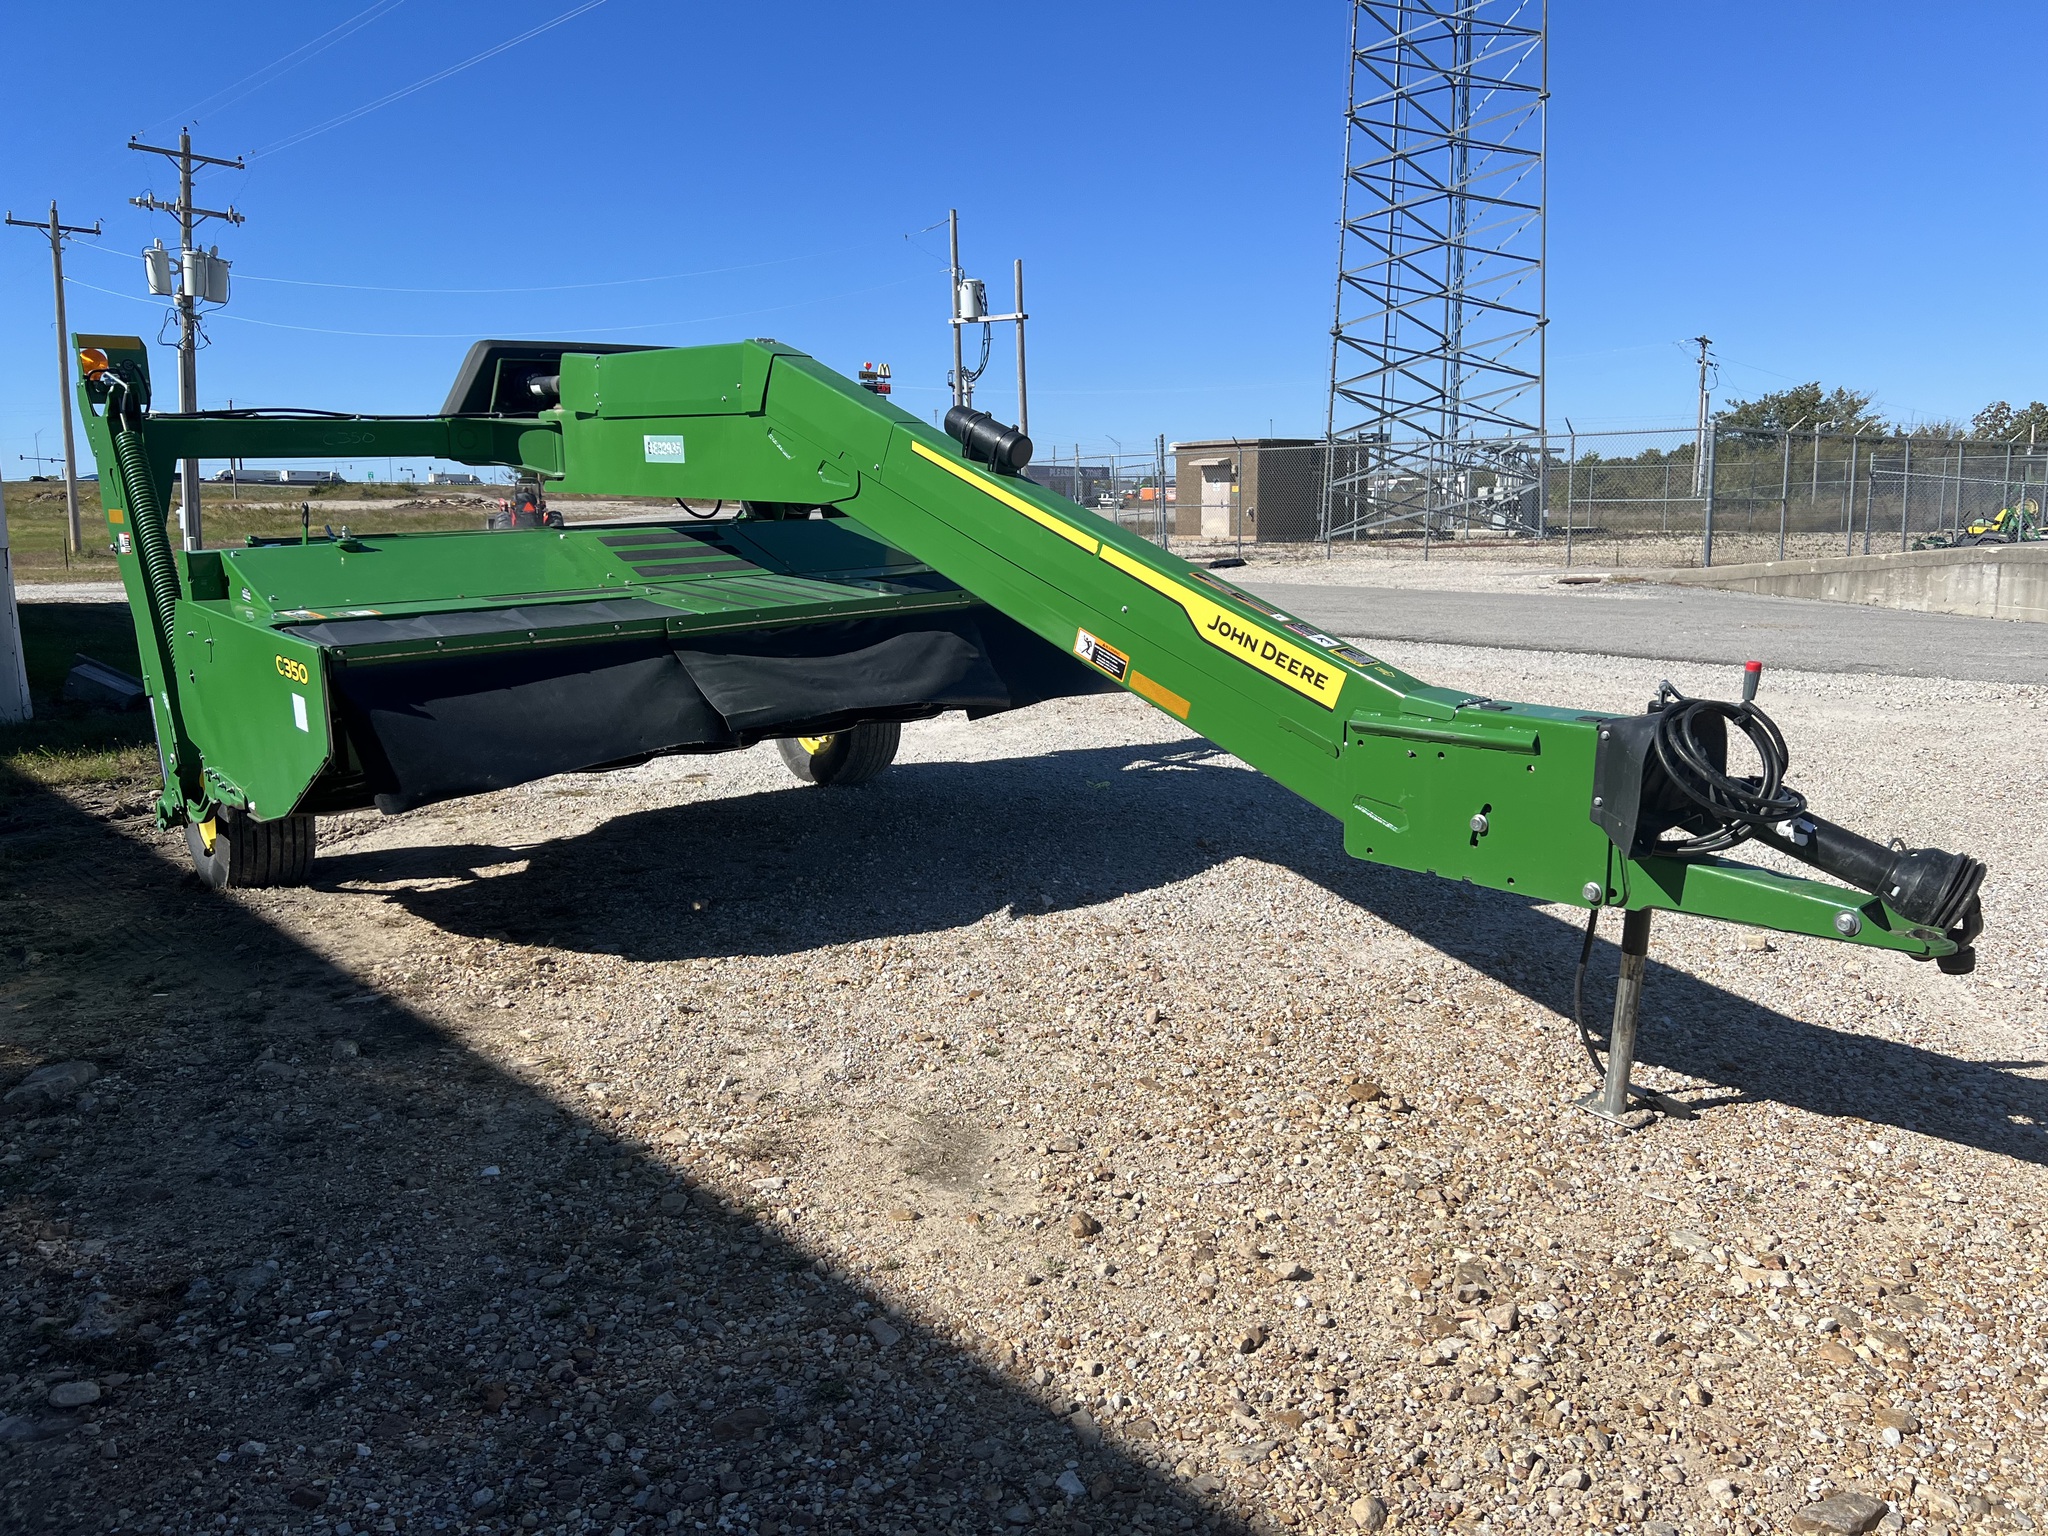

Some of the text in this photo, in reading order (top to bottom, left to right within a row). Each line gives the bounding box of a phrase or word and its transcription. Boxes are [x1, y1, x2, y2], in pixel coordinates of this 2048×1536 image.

[323, 432, 376, 445] C350
[1207, 615, 1328, 690] JOHN DEERE
[275, 654, 308, 685] C350
